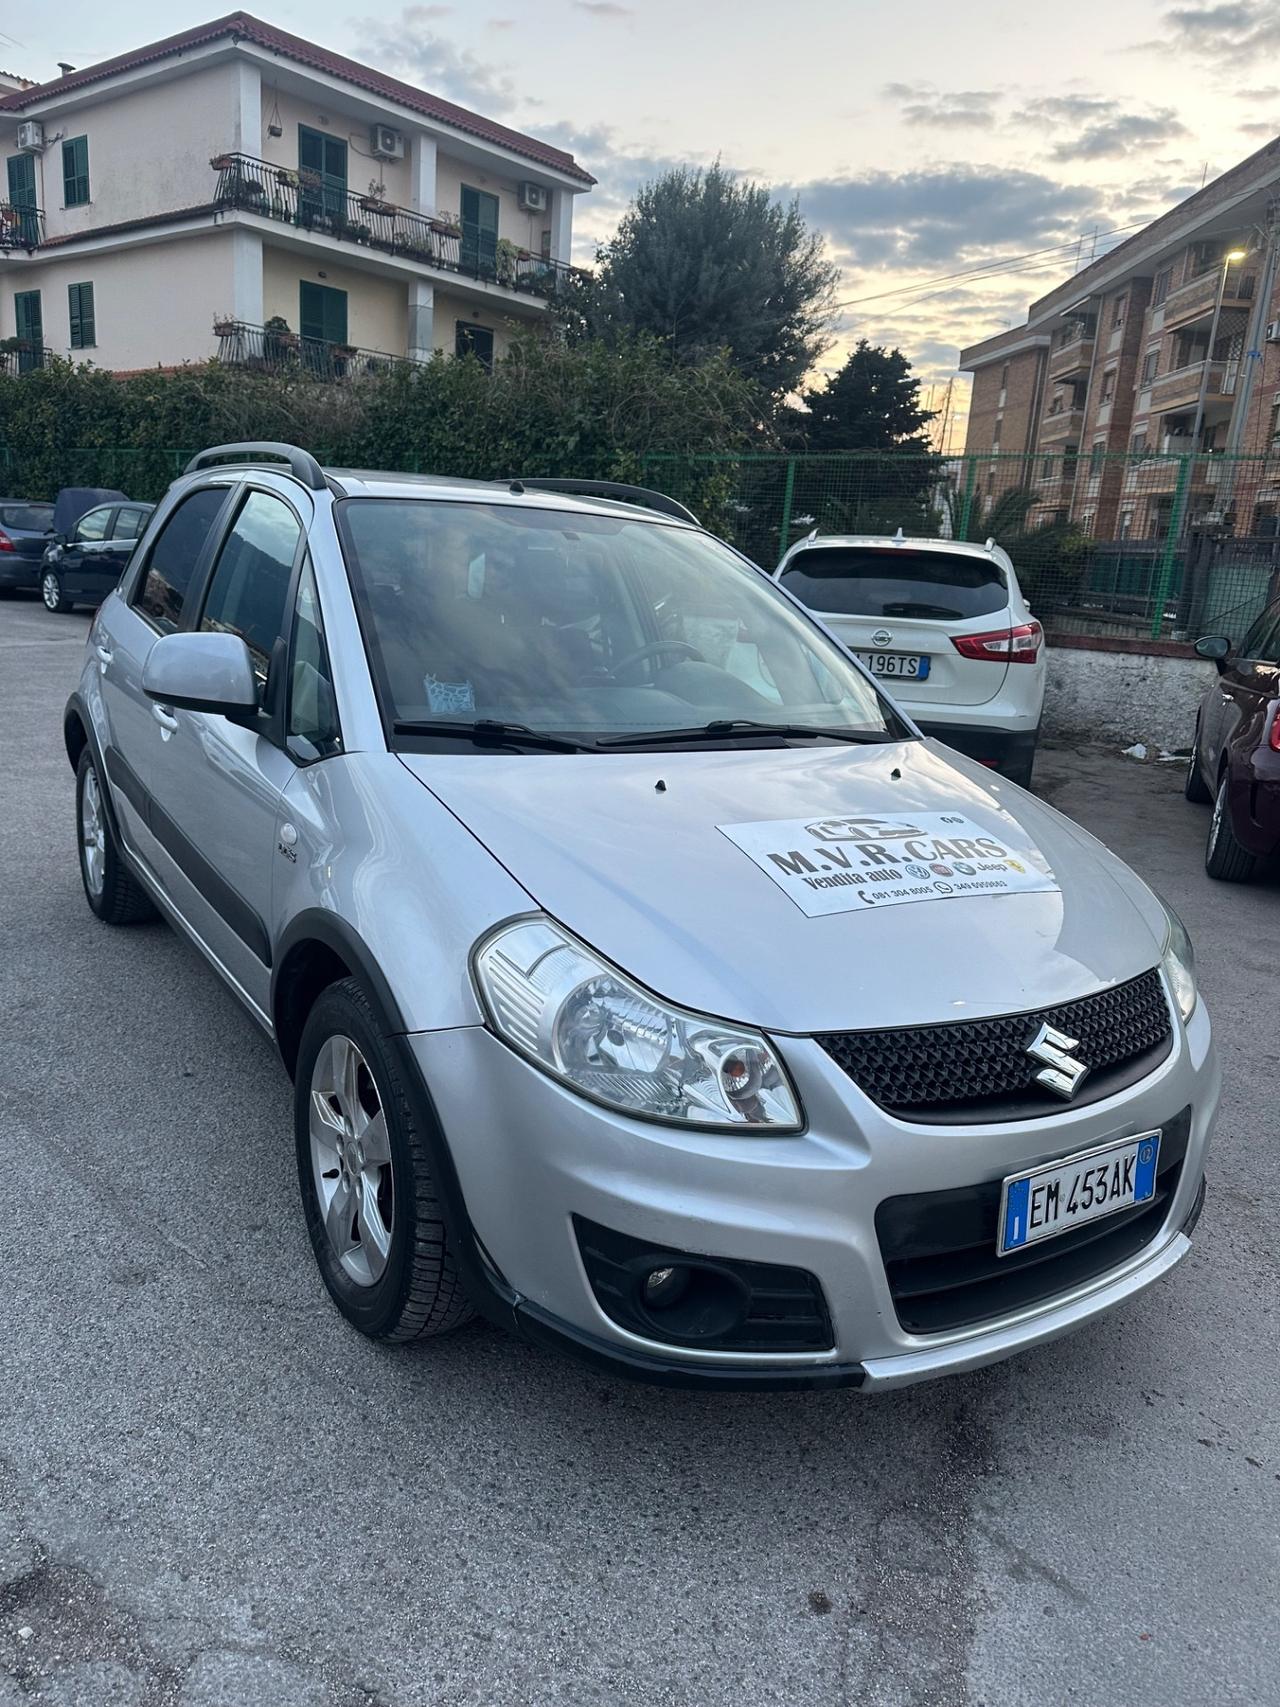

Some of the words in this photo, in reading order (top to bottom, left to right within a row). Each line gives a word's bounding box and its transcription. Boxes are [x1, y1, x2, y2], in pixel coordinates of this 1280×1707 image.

[868, 655, 917, 675] 196TS
[767, 838, 1008, 876] M.V.R.CARS
[977, 862, 1008, 872] Jeep
[802, 872, 868, 890] Vendita
[865, 867, 903, 883] auto
[872, 891, 891, 899] 081
[891, 889, 910, 897] 304
[909, 886, 934, 895] 8005
[1030, 1178, 1060, 1229] EM
[1066, 1153, 1137, 1215] 453AK
